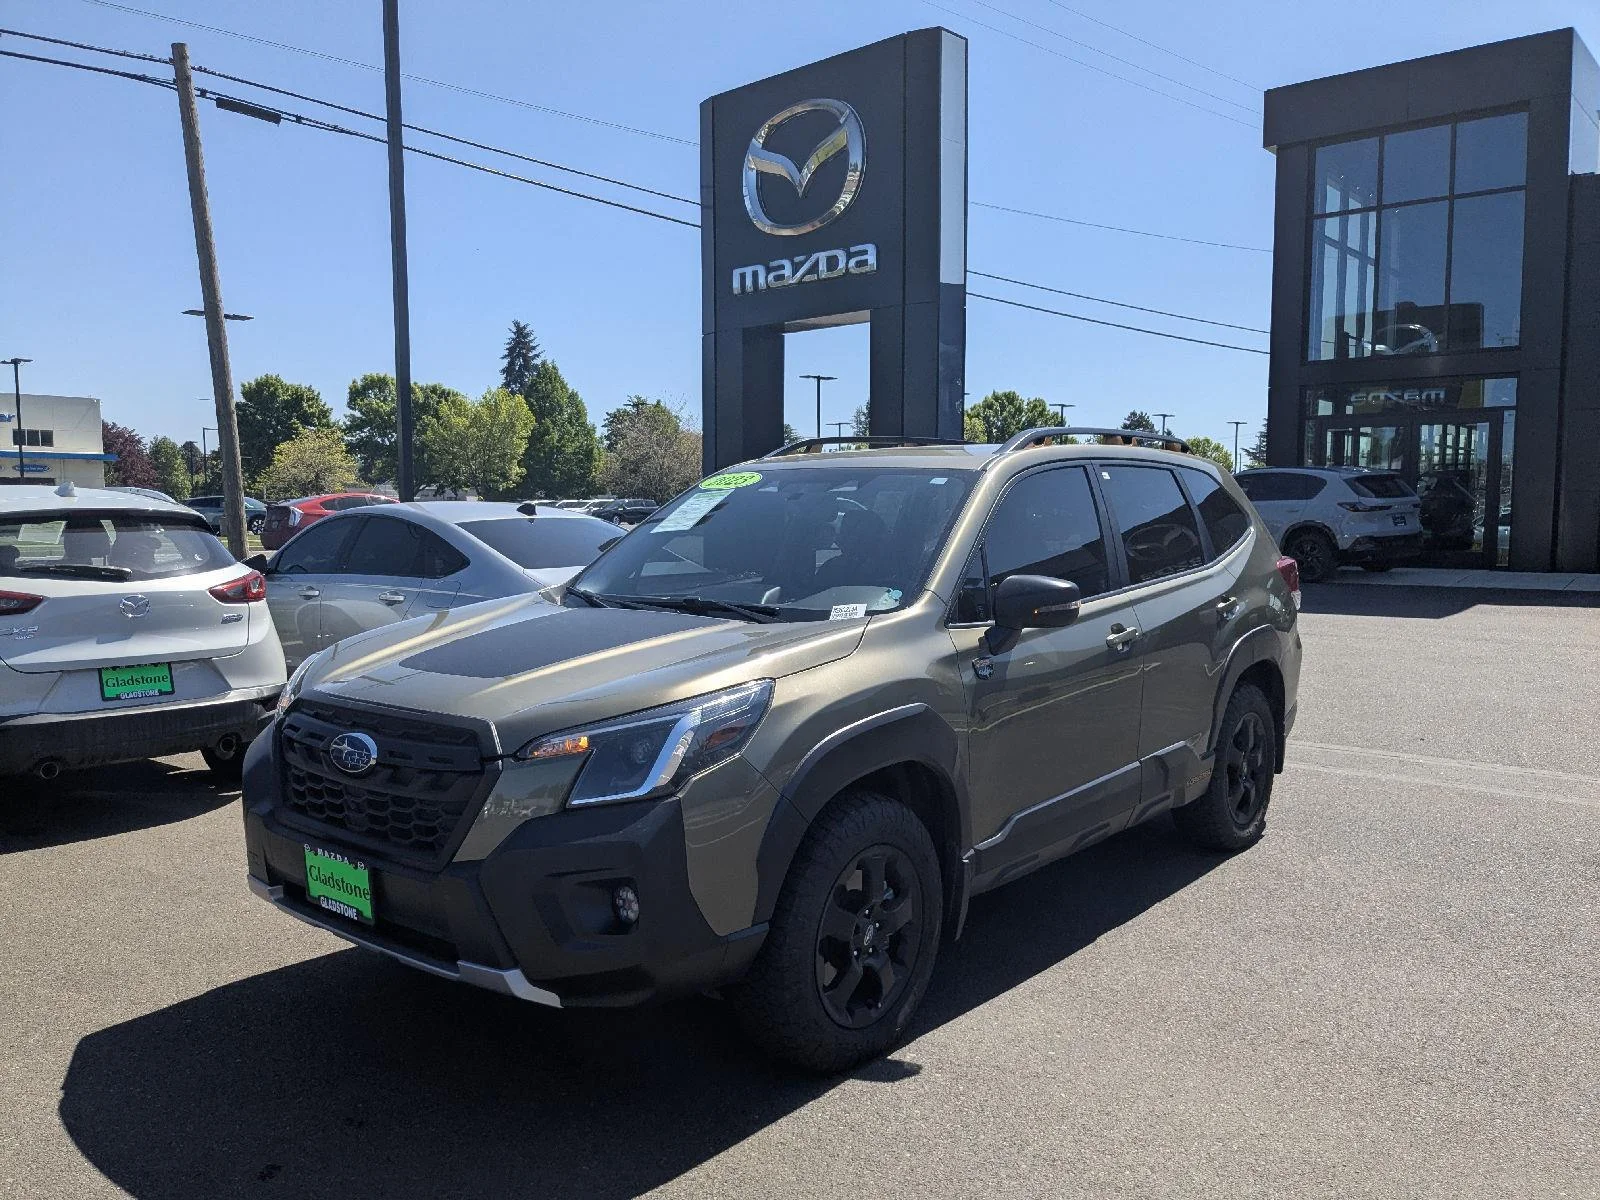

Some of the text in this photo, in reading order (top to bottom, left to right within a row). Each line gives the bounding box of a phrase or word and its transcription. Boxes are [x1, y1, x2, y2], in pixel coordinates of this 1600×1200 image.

[732, 243, 877, 295] mazda
[105, 674, 169, 688] Gladstone
[317, 847, 349, 865] MAZDA
[308, 864, 370, 901] Gladstone
[320, 896, 358, 920] GLADSTONE
